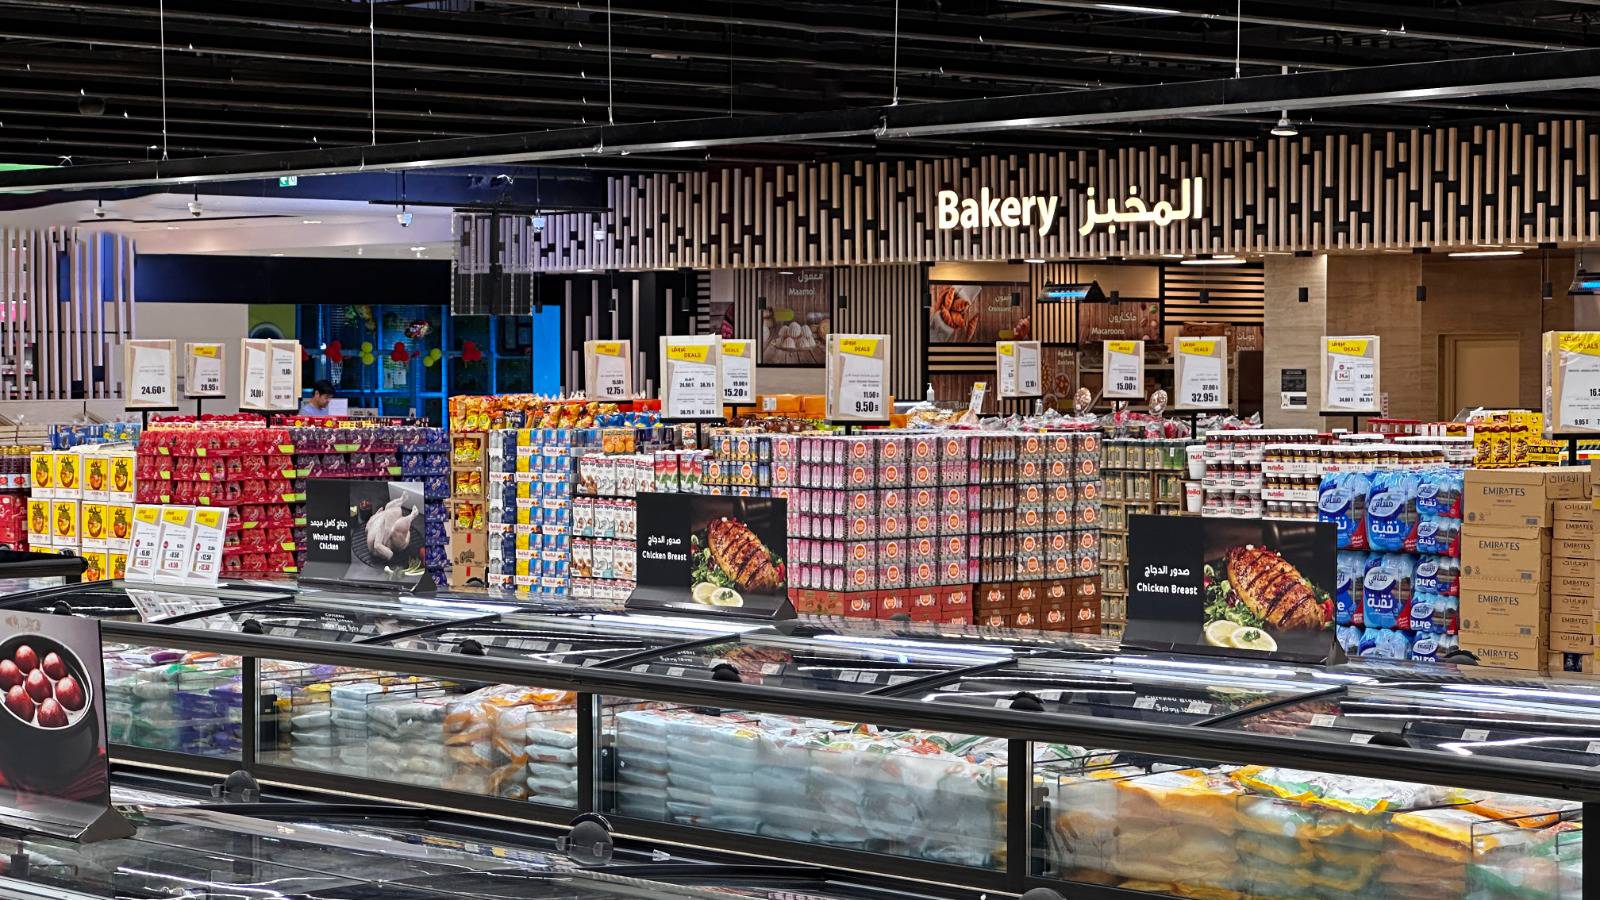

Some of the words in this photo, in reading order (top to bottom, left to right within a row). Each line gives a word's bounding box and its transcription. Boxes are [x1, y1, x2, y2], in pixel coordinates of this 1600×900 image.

[938, 187, 1058, 237] Bakery
[1078, 176, 1203, 237] المخبز
[797, 269, 824, 283] معمول
[1091, 327, 1125, 335] Macaroons
[141, 385, 162, 395] 24.60
[606, 386, 621, 395] 12.75
[1116, 382, 1133, 391] 15.00
[724, 388, 743, 397] 15.20
[1191, 392, 1214, 403] 32.95
[855, 401, 874, 412] 9.50
[1483, 486, 1526, 497] EMIRATES
[337, 519, 348, 530] دجاج
[1371, 520, 1400, 538] نقية
[312, 532, 329, 541] Whole
[329, 533, 346, 541] Frozen
[647, 534, 666, 547] الدجاج
[665, 536, 682, 547] صدور
[319, 542, 339, 550] Chicken
[1478, 540, 1520, 551] EMIRATES
[1563, 542, 1591, 550] EMIRATES
[642, 550, 667, 560] Chicken
[667, 551, 687, 562] Breast
[1144, 564, 1169, 578] الدجاج
[1169, 567, 1190, 577] صدور
[1416, 577, 1437, 588] pure
[1562, 579, 1590, 587] EMIRATES
[1136, 582, 1170, 594] Chicken
[1171, 584, 1199, 596] Breast
[1367, 592, 1394, 613] نقية
[1477, 594, 1519, 606] EMIRATES
[1410, 618, 1432, 630] pure
[1561, 616, 1589, 625] EMIRATES
[1477, 648, 1519, 660] EMIRATES
